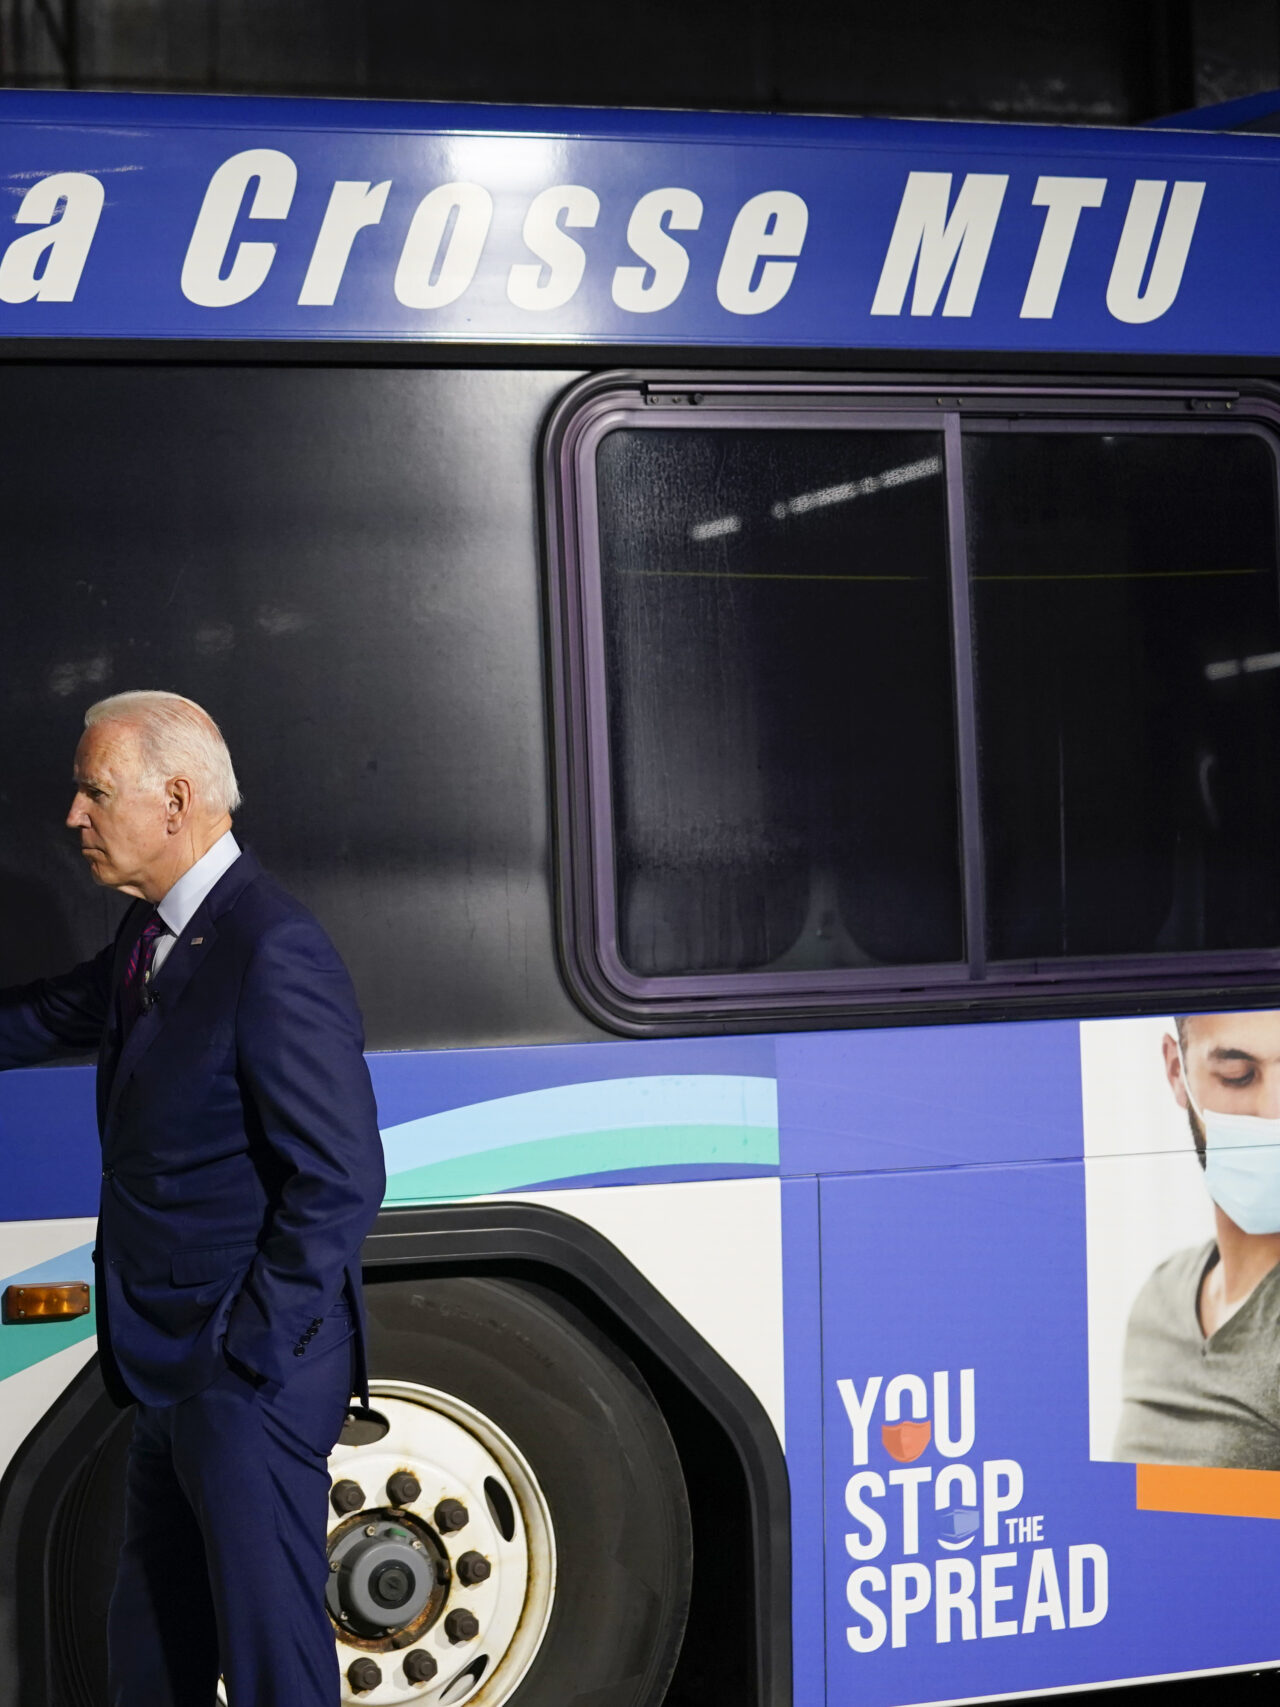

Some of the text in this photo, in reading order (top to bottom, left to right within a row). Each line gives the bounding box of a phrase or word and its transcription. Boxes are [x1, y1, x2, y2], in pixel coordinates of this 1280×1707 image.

[180, 148, 809, 315] Crosse
[870, 171, 1207, 325] MTU
[836, 1368, 976, 1466] YOU
[844, 1459, 1045, 1561] STOP THE
[845, 1543, 1110, 1654] SPREAD
